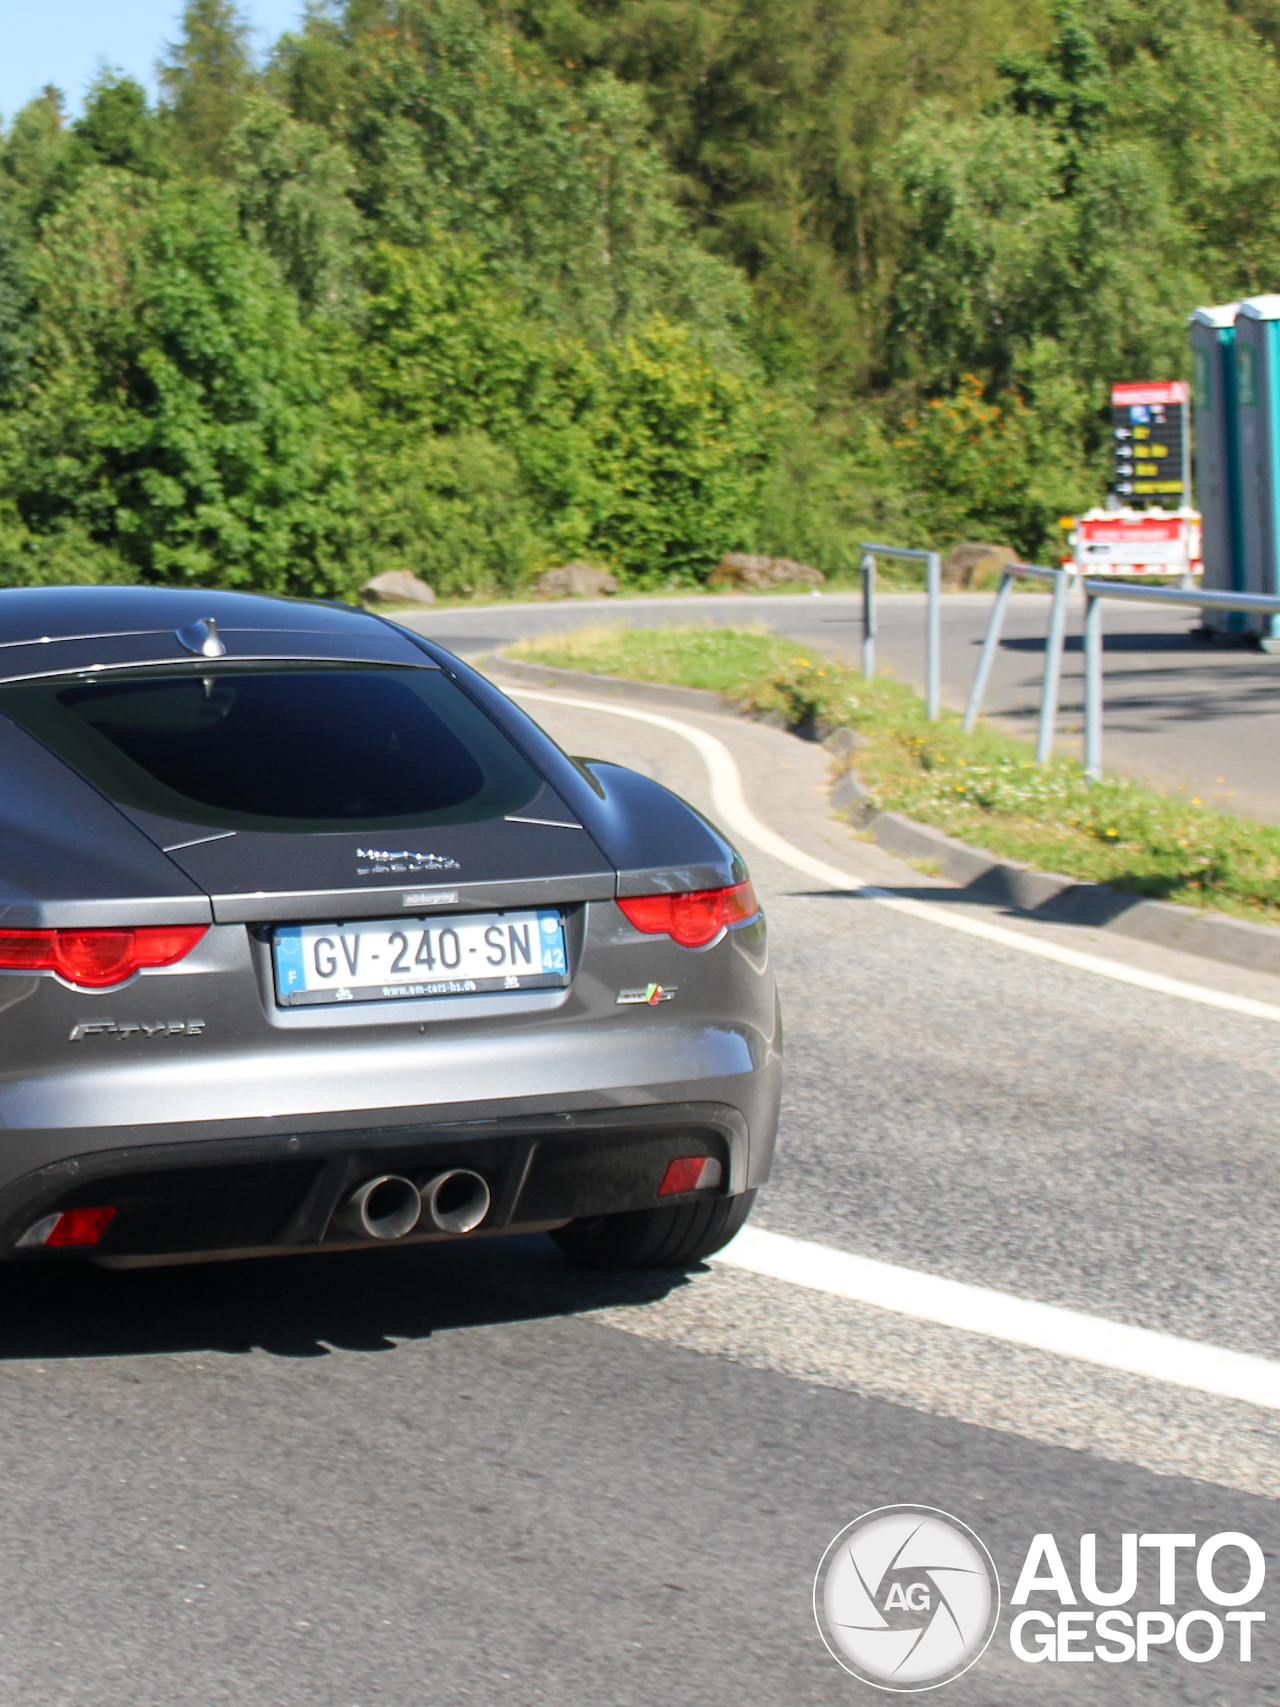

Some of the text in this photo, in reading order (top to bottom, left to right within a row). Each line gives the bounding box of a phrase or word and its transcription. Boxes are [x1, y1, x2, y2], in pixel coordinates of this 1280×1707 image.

[406, 892, 455, 904] nürburgring
[543, 949, 565, 969] 42
[288, 970, 297, 985] F
[68, 1017, 207, 1042] F-TYPE
